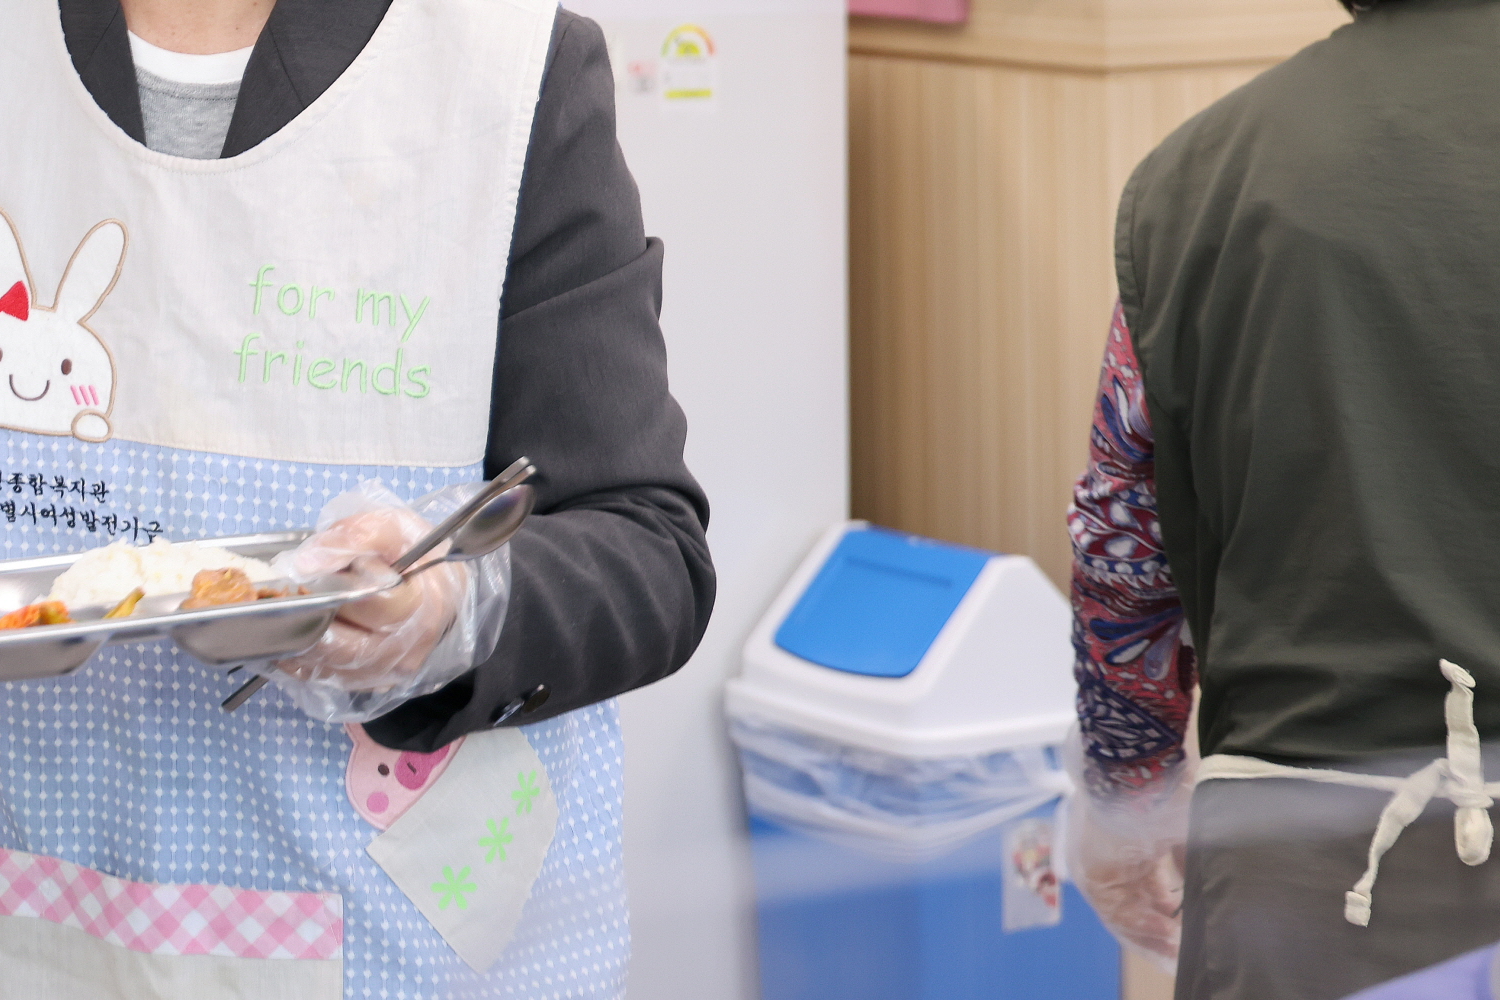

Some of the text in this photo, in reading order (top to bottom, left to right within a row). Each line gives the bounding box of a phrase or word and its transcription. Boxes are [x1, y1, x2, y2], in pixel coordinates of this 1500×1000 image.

[249, 264, 431, 343] for my
[233, 332, 431, 399] friends
